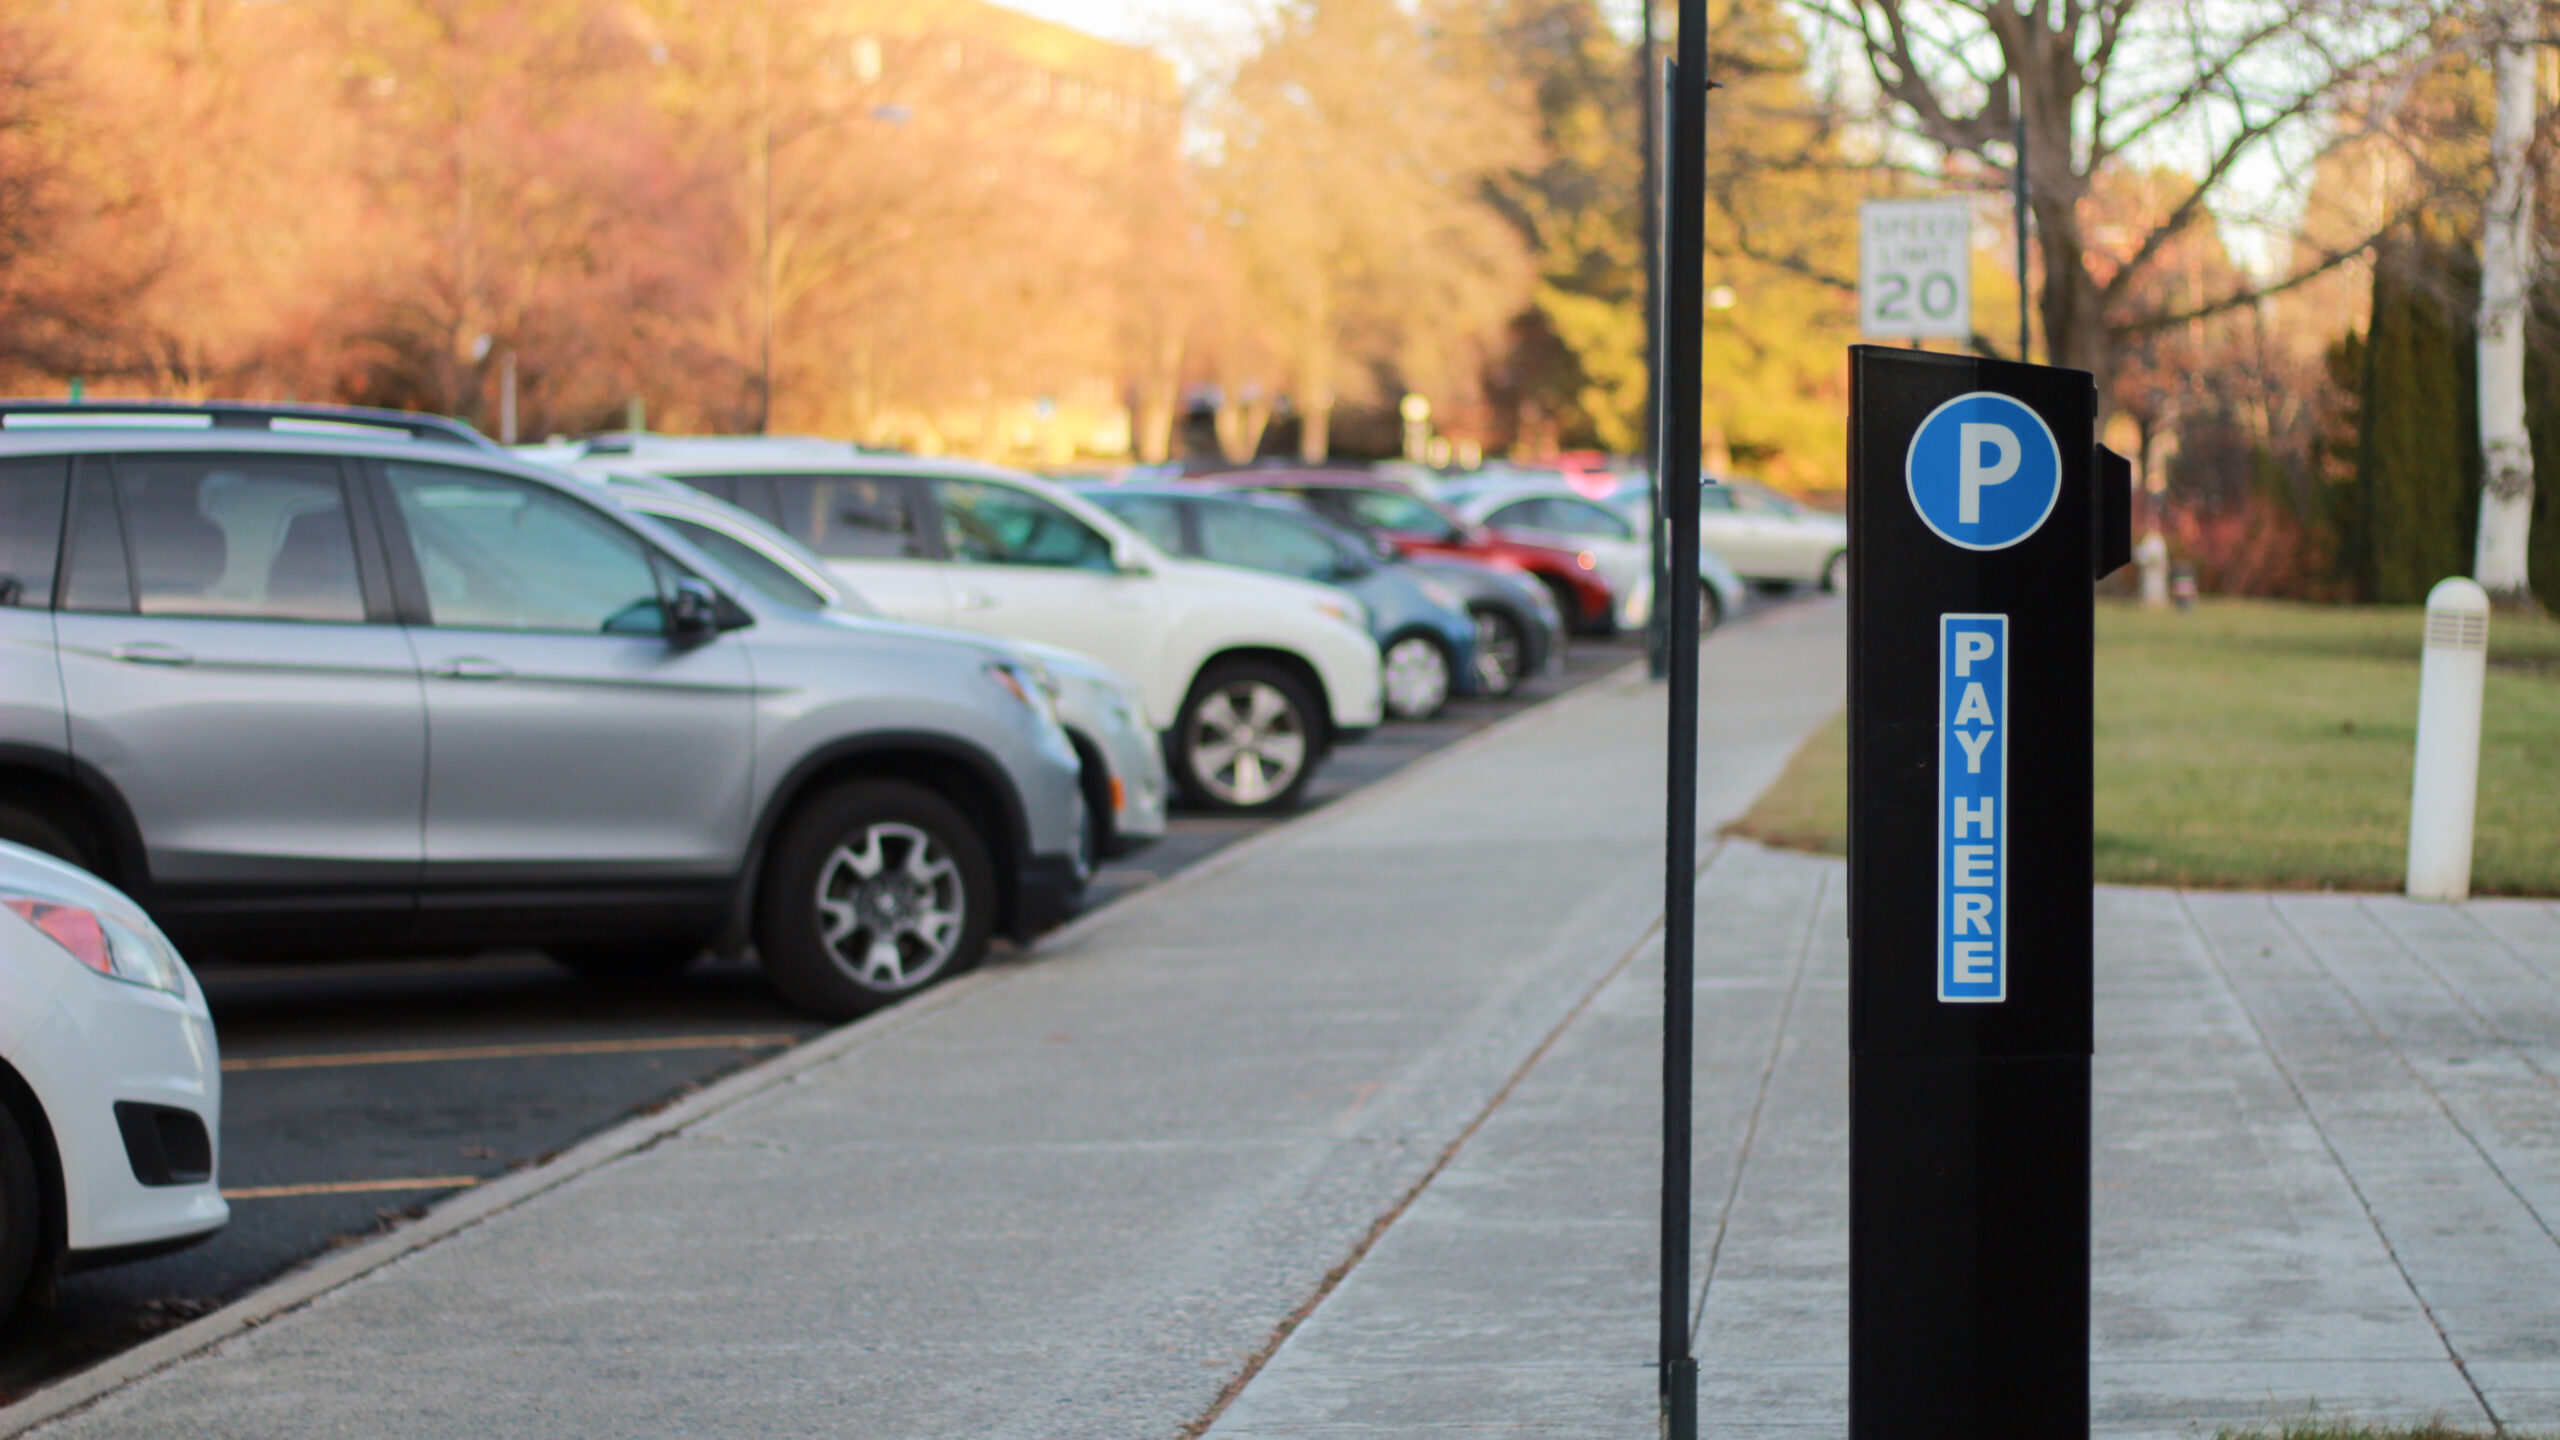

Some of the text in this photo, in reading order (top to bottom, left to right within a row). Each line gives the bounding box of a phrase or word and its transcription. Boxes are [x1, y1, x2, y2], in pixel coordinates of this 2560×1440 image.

[1874, 214, 1959, 238] SPEED
[1880, 244, 1947, 266] LIMIT
[1874, 271, 1958, 321] 20
[1959, 423, 2021, 523] P
[1953, 632, 1995, 983] PAY HERE
